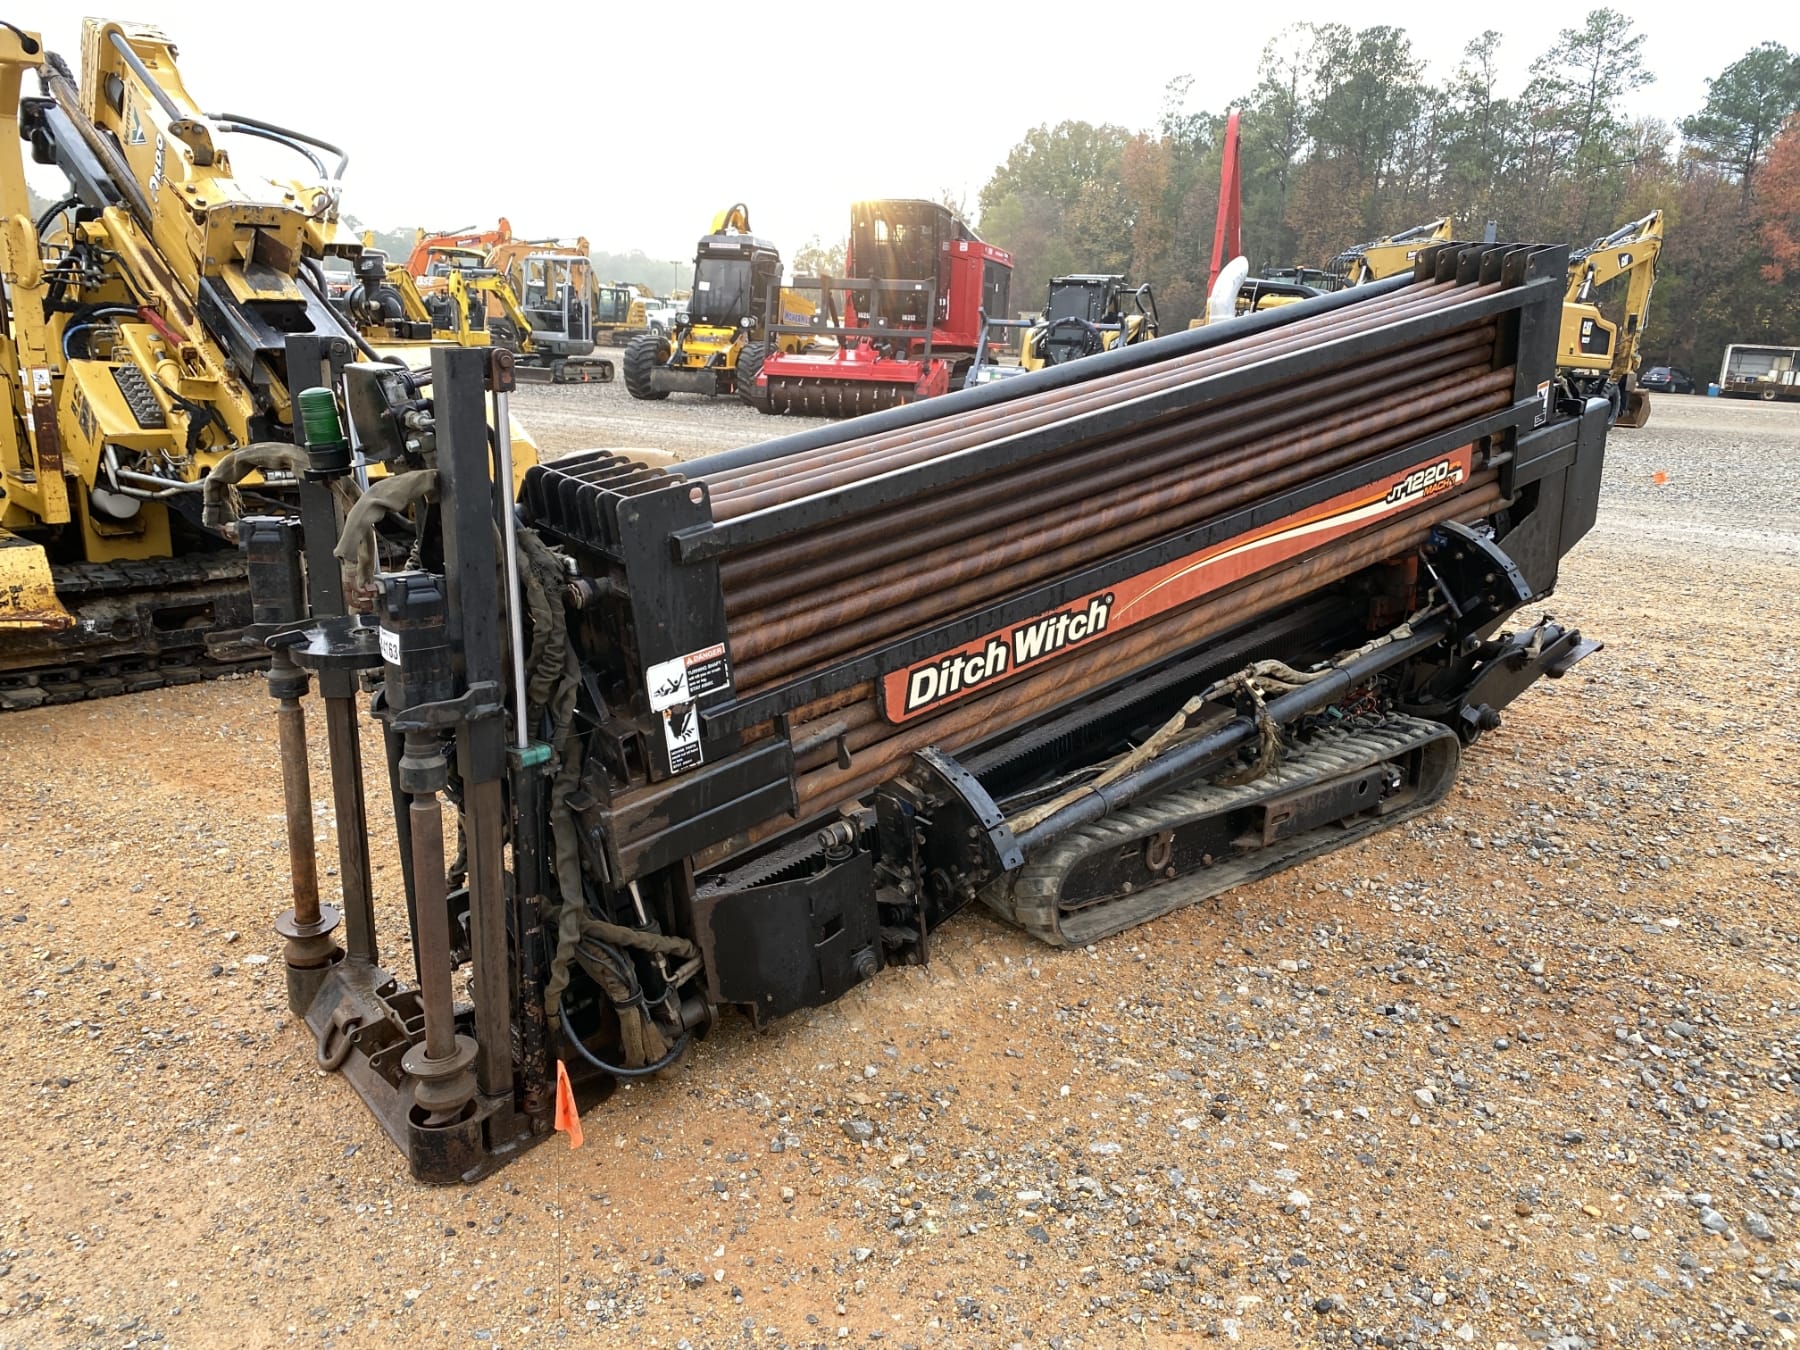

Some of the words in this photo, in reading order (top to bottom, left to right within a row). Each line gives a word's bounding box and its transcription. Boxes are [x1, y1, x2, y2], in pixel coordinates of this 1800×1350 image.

[1387, 461, 1449, 501] JT1220
[693, 647, 722, 662] DANGER
[908, 641, 1007, 709] Ditch
[1015, 599, 1108, 664] Witch
